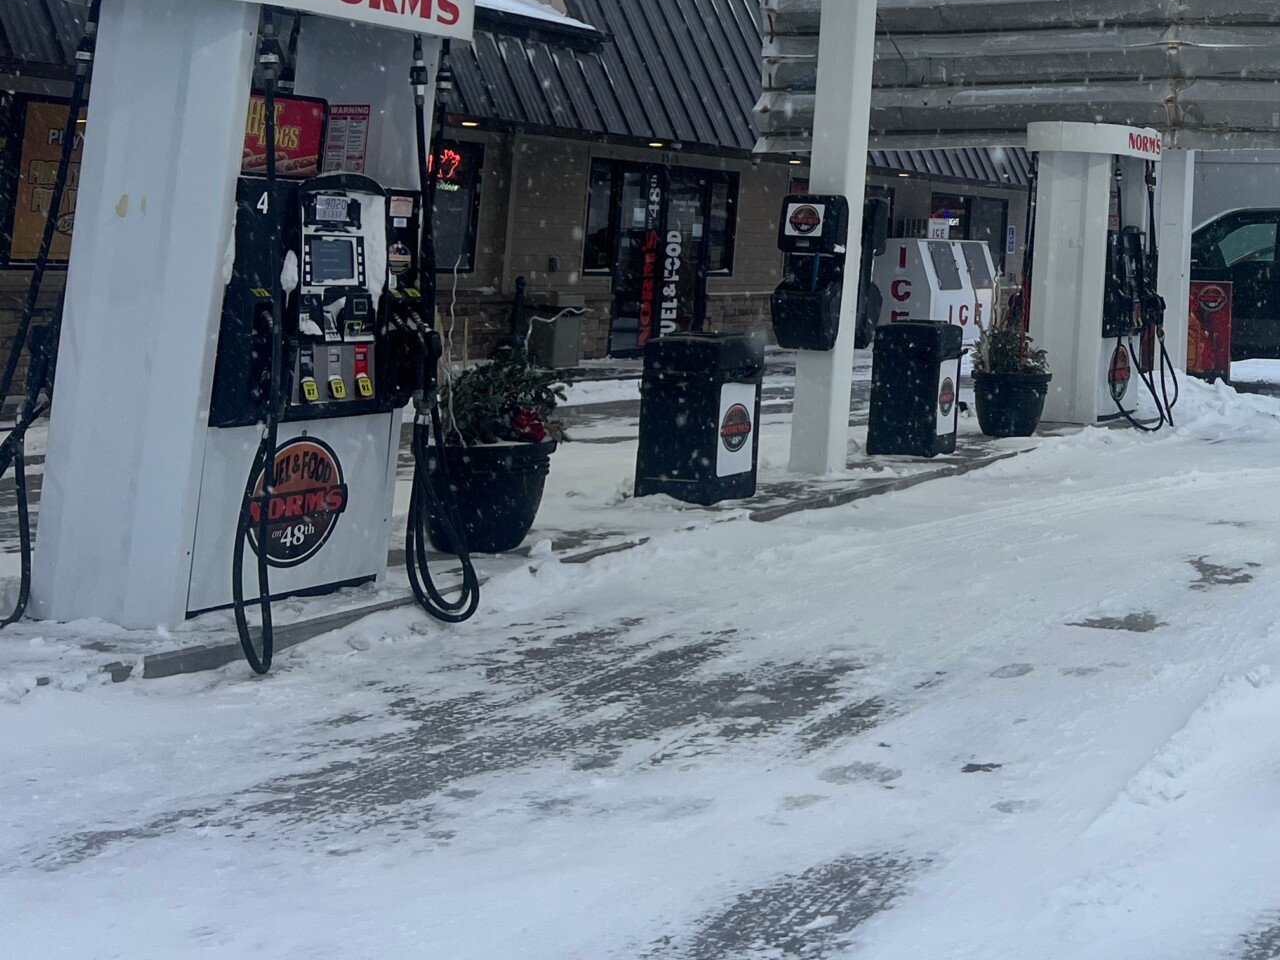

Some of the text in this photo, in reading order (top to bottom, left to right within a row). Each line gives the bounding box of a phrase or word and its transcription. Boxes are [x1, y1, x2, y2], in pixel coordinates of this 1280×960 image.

[330, 106, 370, 115] WARNING
[48, 128, 80, 150] Ply
[1128, 132, 1161, 155] NORM'S
[256, 191, 269, 215] 4
[648, 174, 661, 218] 48th
[932, 228, 945, 238] ICE
[660, 230, 682, 338] UEL & FOOD
[306, 388, 315, 396] 87
[334, 385, 343, 393] 87
[272, 450, 332, 488] UEL & FOOD
[271, 523, 315, 547] on 48th
